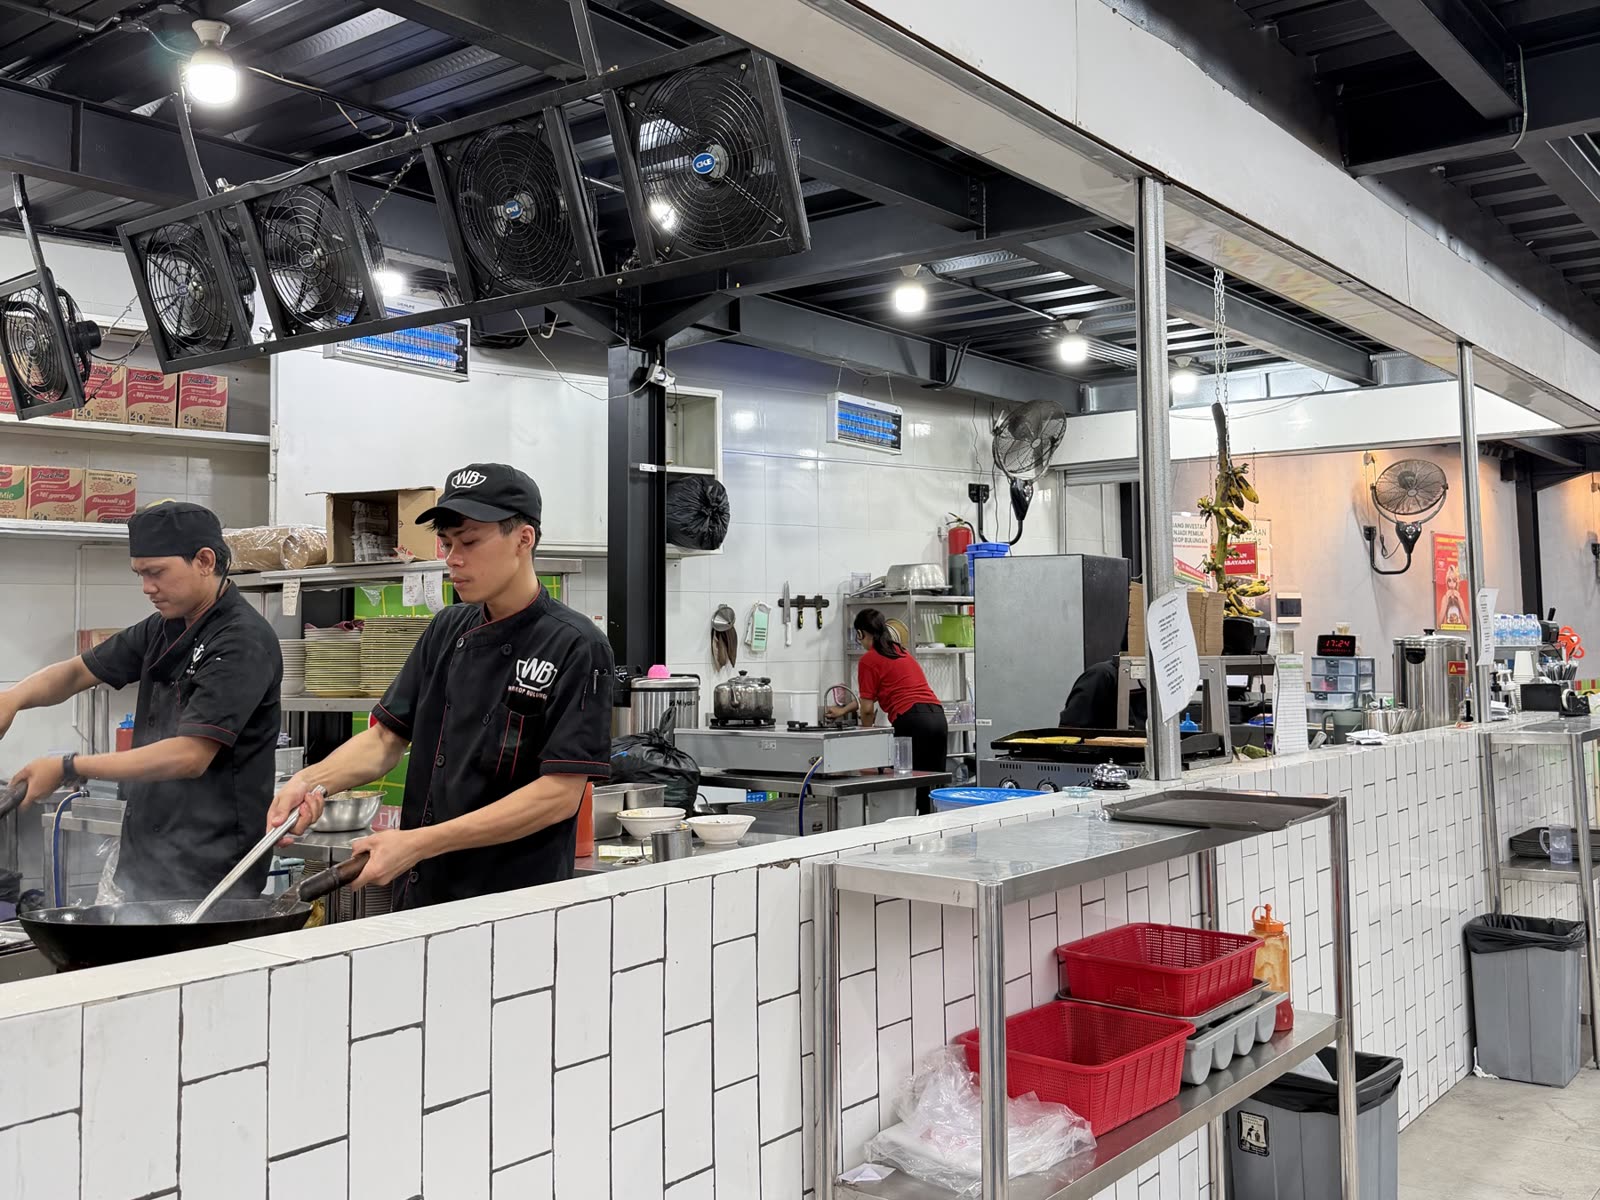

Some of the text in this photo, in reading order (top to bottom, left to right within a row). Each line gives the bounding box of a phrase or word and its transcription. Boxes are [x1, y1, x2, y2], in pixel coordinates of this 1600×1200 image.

[696, 158, 712, 167] CKE
[129, 412, 146, 423] 40
[183, 415, 199, 426] 40
[456, 470, 480, 485] WB
[1326, 639, 1350, 648] 17:24
[521, 657, 555, 684] WB
